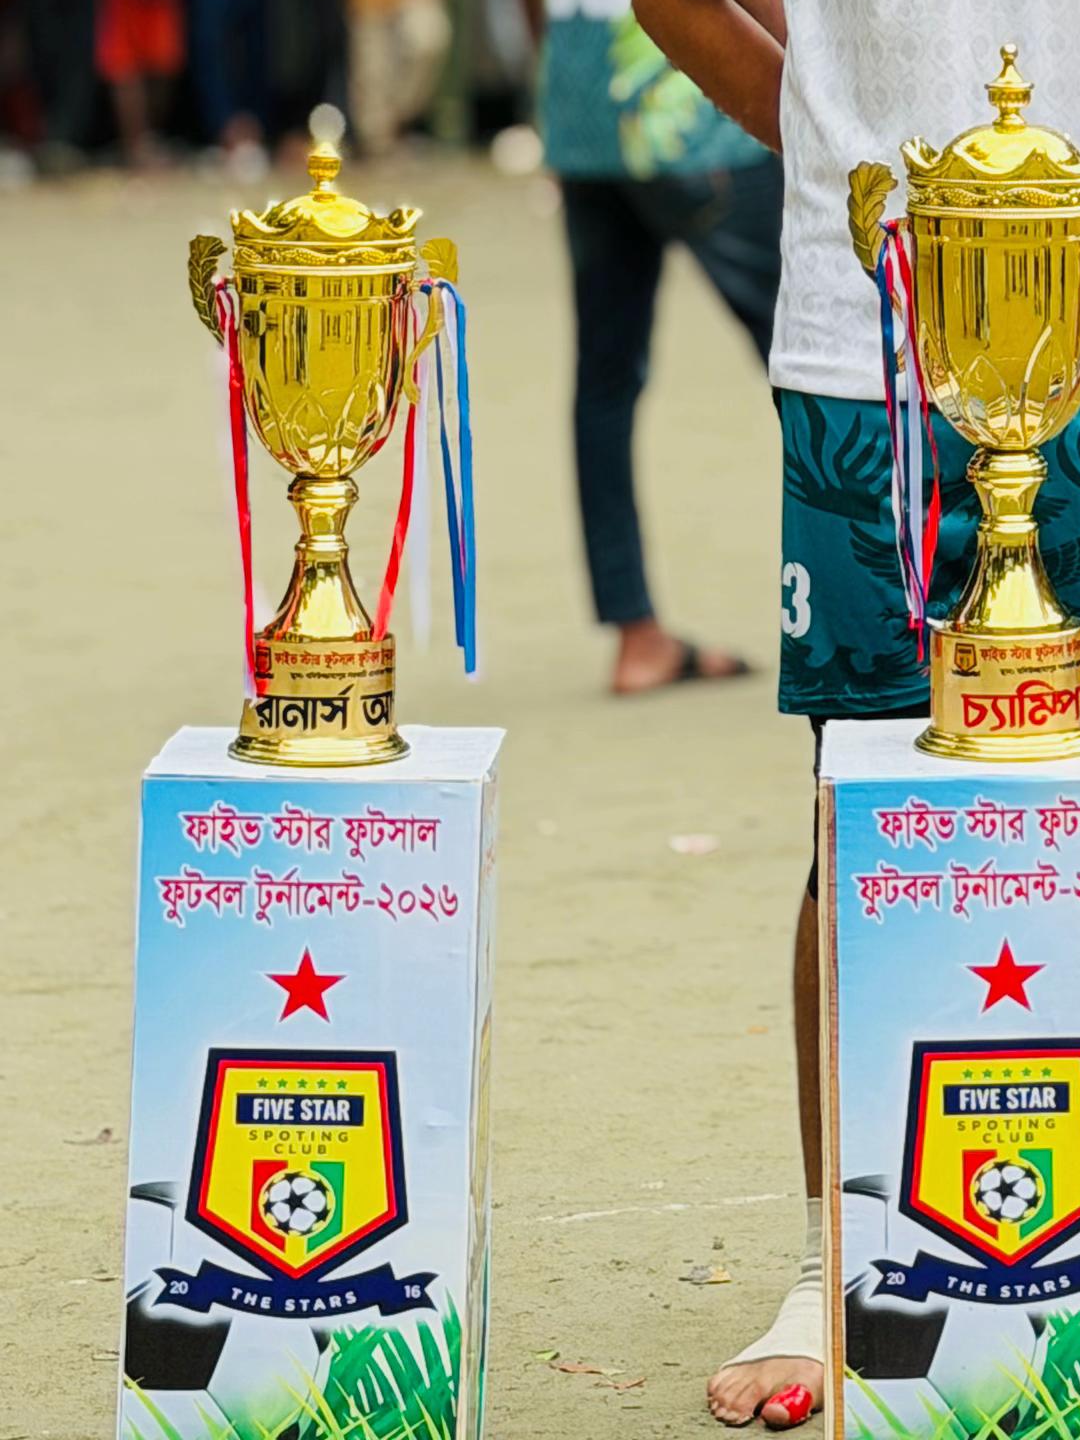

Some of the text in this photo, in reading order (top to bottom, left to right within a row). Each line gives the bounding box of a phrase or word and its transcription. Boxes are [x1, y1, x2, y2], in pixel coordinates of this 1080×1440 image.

[256, 684, 355, 730] রানার্স
[183, 803, 441, 861] ফাইভ স্টার ফুটসাল
[878, 798, 957, 848] ফাইভ
[964, 797, 1028, 843] স্টার
[160, 866, 458, 925] ফুটবল টুর্নামেন্ট-২০২৬
[857, 862, 943, 920] ফুটবল
[252, 1098, 350, 1121] FIVE STAR
[959, 1087, 1057, 1110] FIVE STAR
[249, 1130, 349, 1142] SPOTING
[957, 1118, 1057, 1131] SPOTING
[982, 1131, 1034, 1143] CLUB
[273, 1144, 327, 1154] CLUB
[170, 1281, 188, 1295] 20
[886, 1271, 906, 1285] 20
[947, 1275, 1071, 1298] THE STARS
[231, 1287, 358, 1312] THE STARS
[404, 1284, 421, 1299] 16
